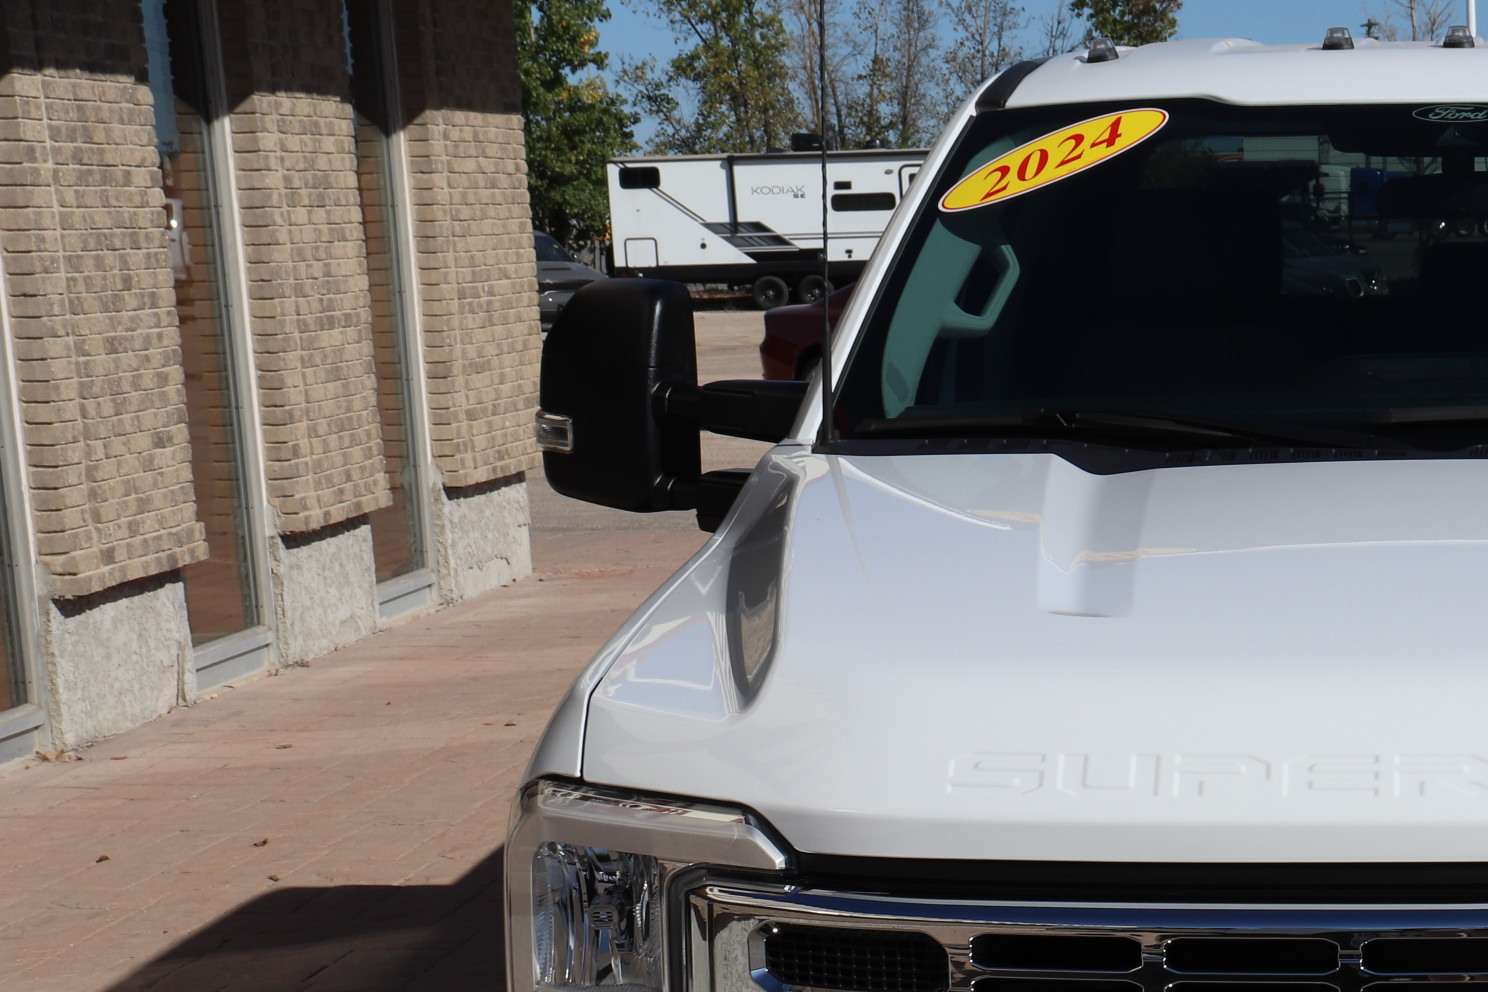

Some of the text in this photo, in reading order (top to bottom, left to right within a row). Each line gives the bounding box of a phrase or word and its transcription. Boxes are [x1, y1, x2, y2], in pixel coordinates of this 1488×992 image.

[1428, 106, 1488, 120] Ford
[979, 115, 1123, 202] 2024
[751, 185, 806, 195] KODIAK
